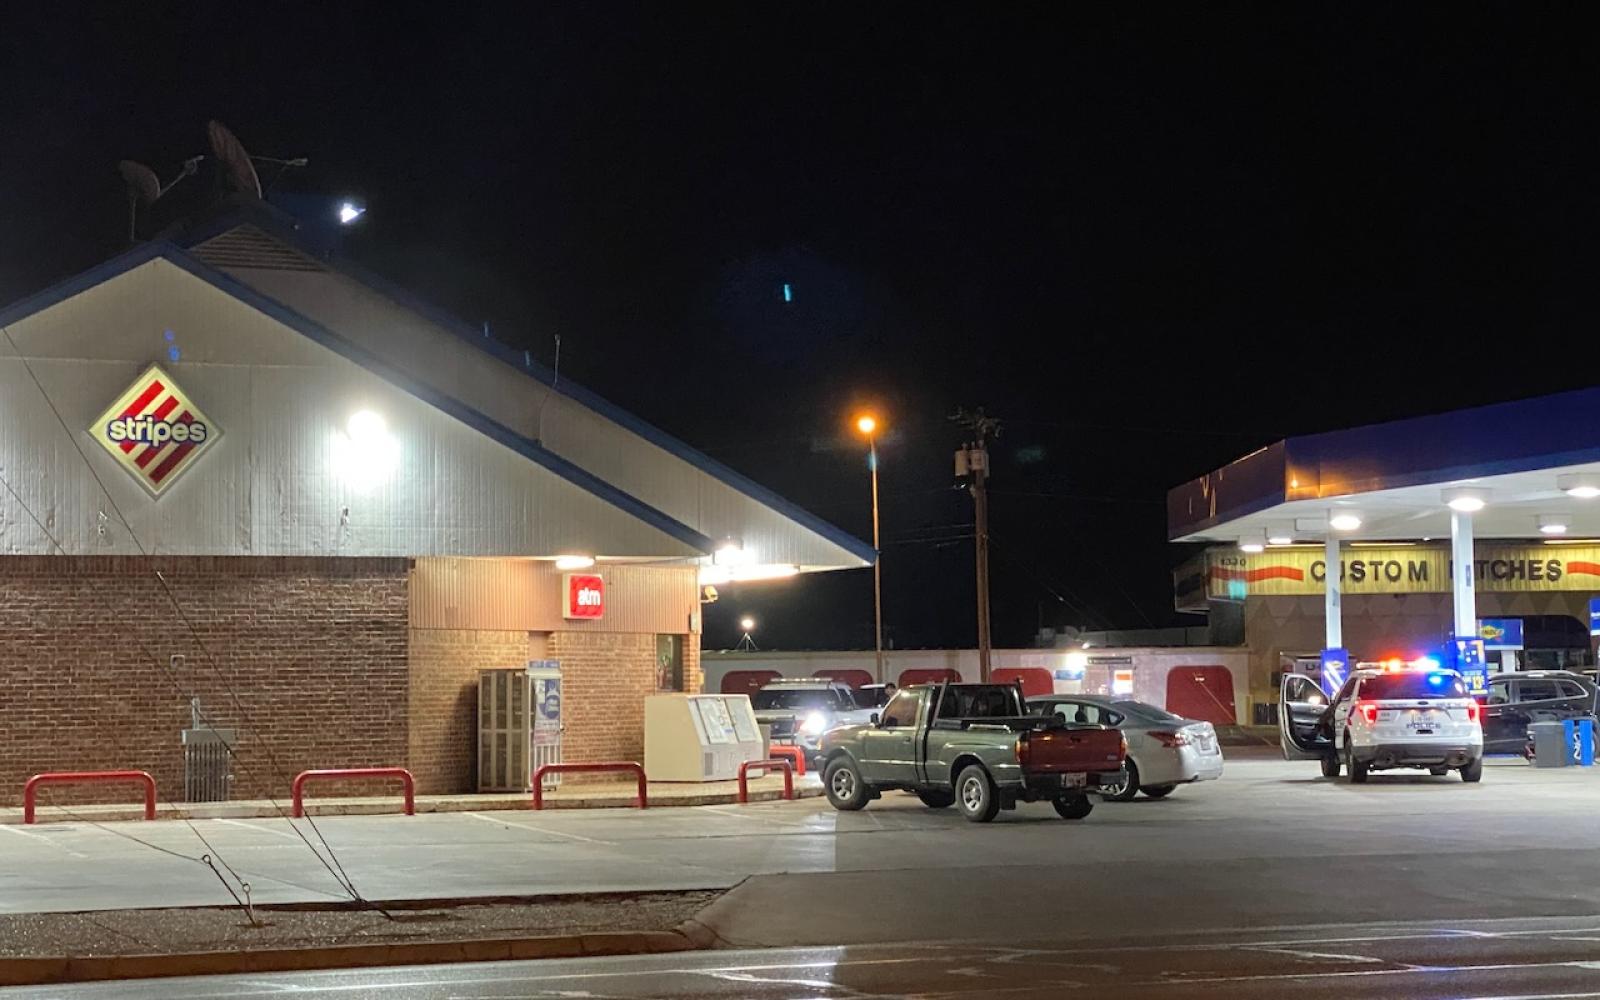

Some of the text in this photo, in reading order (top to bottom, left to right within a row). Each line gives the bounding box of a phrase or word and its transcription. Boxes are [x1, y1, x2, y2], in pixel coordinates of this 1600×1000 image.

[108, 415, 207, 447] stripes
[1449, 560, 1562, 581] TCHES
[577, 586, 601, 606] atm
[1406, 721, 1441, 729] POLICE
